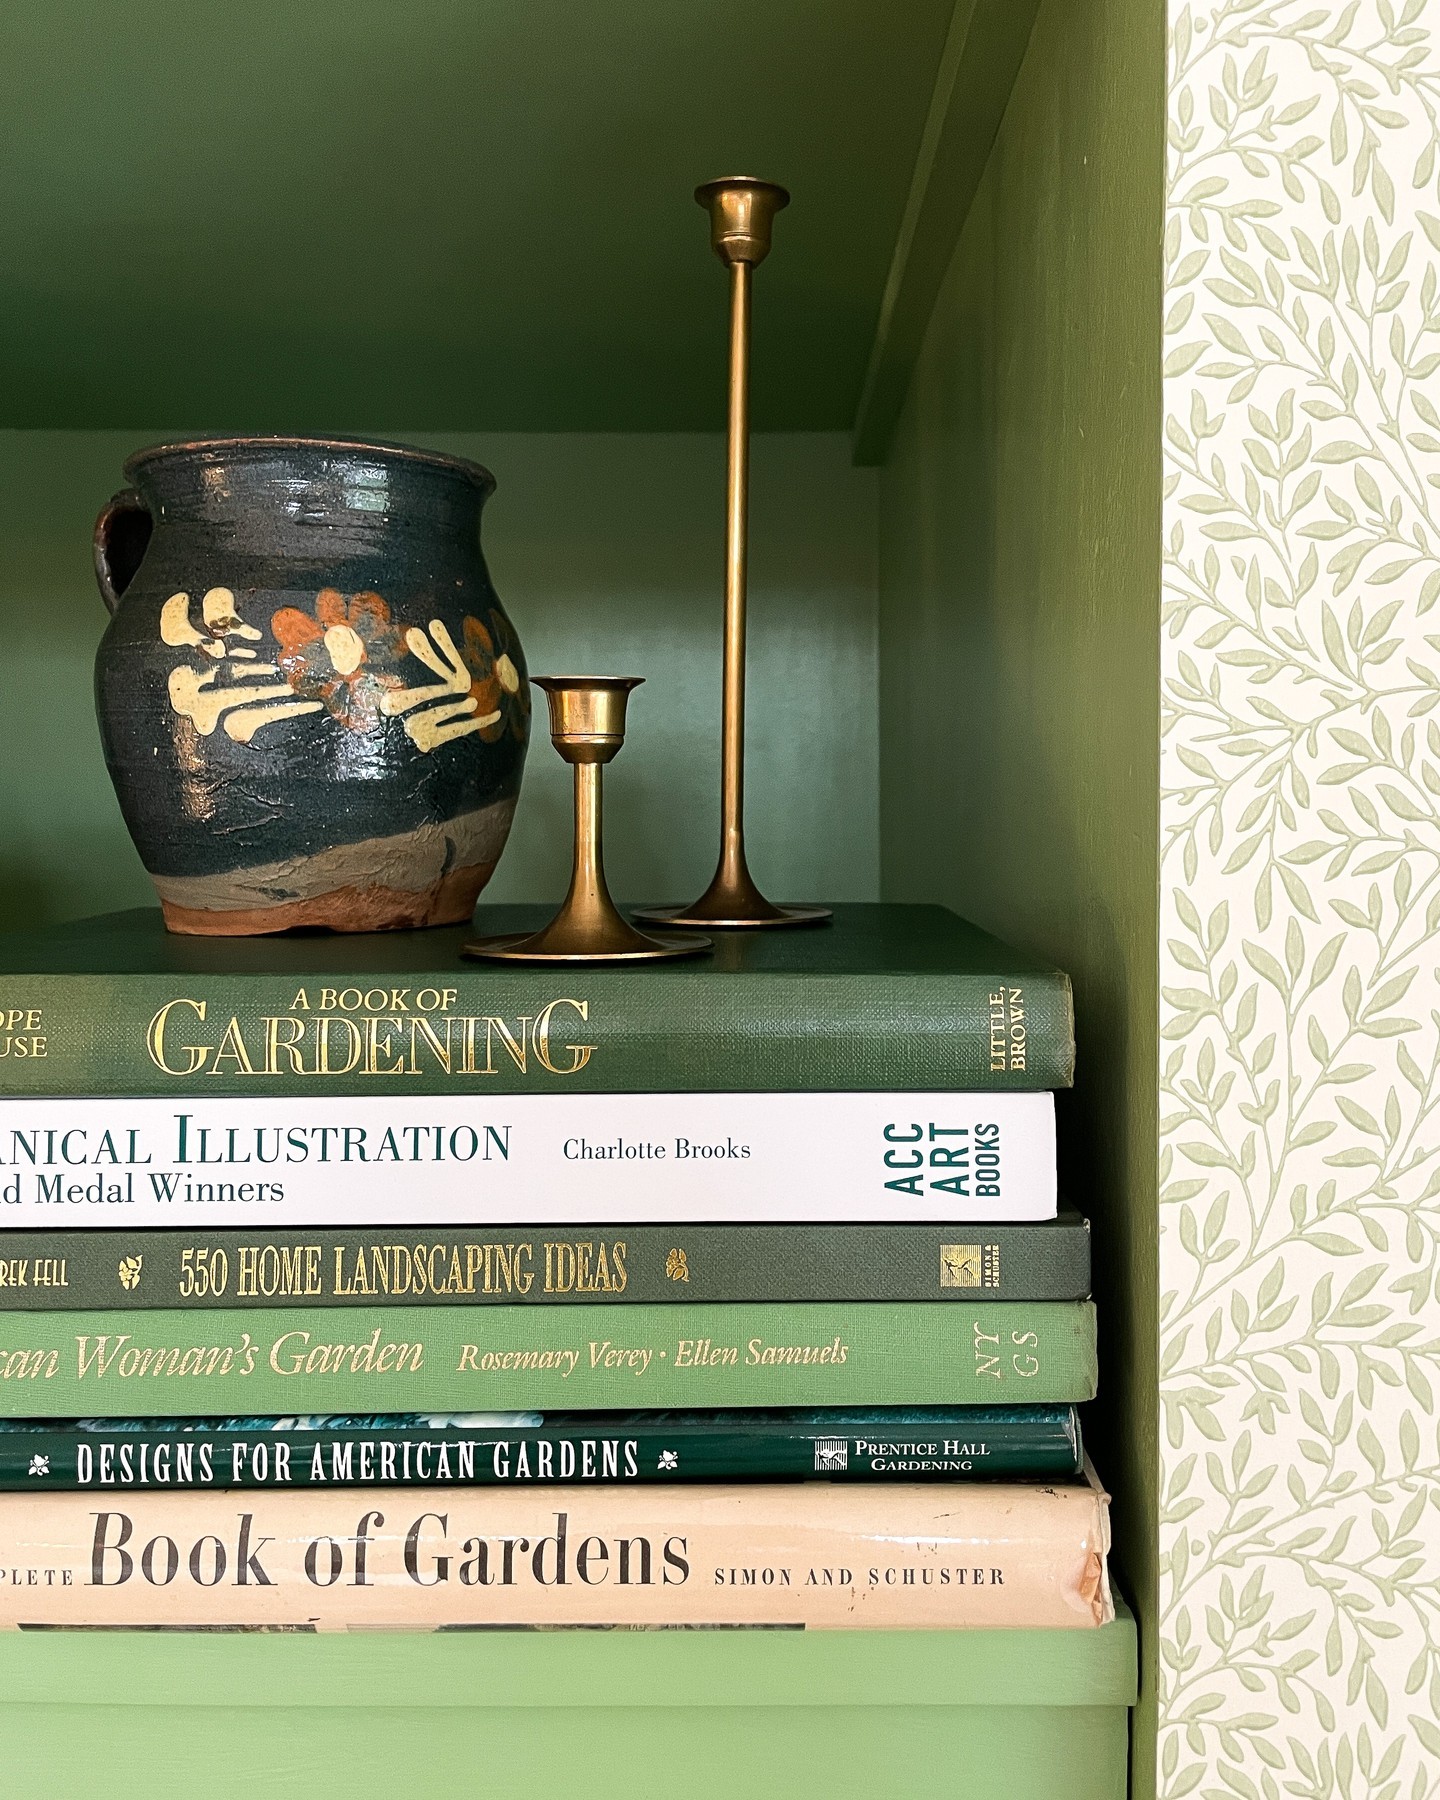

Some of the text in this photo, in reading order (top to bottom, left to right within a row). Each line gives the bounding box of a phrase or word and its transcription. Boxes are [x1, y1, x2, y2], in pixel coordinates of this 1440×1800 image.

[0, 1009, 42, 1031] PE
[289, 987, 457, 1011] A BOOK OF
[146, 998, 597, 1076] GARDENING
[988, 986, 1007, 1072] LITTLE,
[1009, 987, 1028, 1071] BROWN
[0, 1114, 513, 1166] NICAL ILLUSTRATION
[563, 1137, 751, 1160] Charlotte Brooks
[883, 1123, 924, 1197] ACC
[929, 1123, 970, 1197] ART
[974, 1123, 1001, 1197] BOOKS
[0, 1172, 285, 1204] d Medal Winners
[32, 1259, 69, 1287] FELL
[179, 1241, 628, 1297] 550 HOME LANDSCAPING IDEAS
[74, 1333, 259, 1379] Woman’s
[270, 1328, 425, 1375] Garden
[455, 1336, 849, 1378] Rosemary Verey Ellen Samuels
[76, 1440, 638, 1484] DESIGNS FOR AMERICAN GARDENS
[854, 1440, 991, 1457] PRENTICE HALL
[870, 1458, 973, 1472] GARDENING
[84, 1512, 279, 1587] Book
[304, 1511, 385, 1587] of
[403, 1512, 690, 1587] Gardens
[714, 1567, 1005, 1586] SIMON AND SCHUSTER
